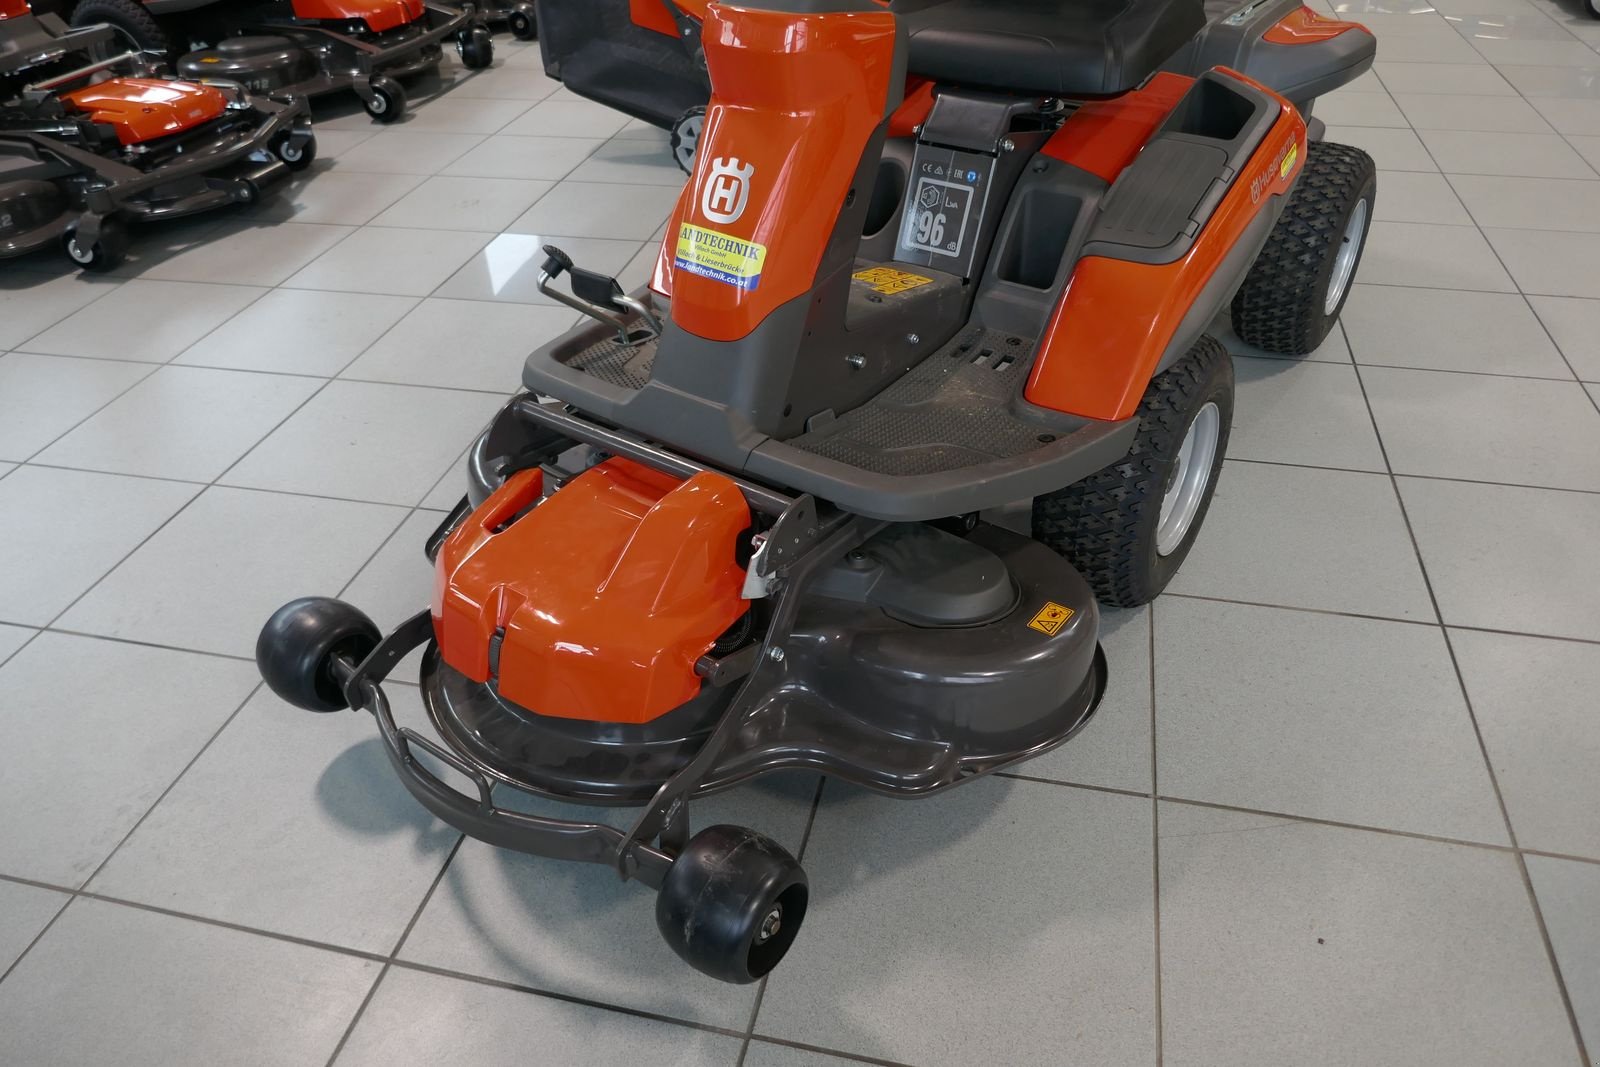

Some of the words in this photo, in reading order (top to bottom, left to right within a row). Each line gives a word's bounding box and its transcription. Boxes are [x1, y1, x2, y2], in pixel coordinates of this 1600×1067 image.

[0, 214, 14, 228] 2
[917, 210, 947, 247] 96
[947, 241, 957, 251] dB
